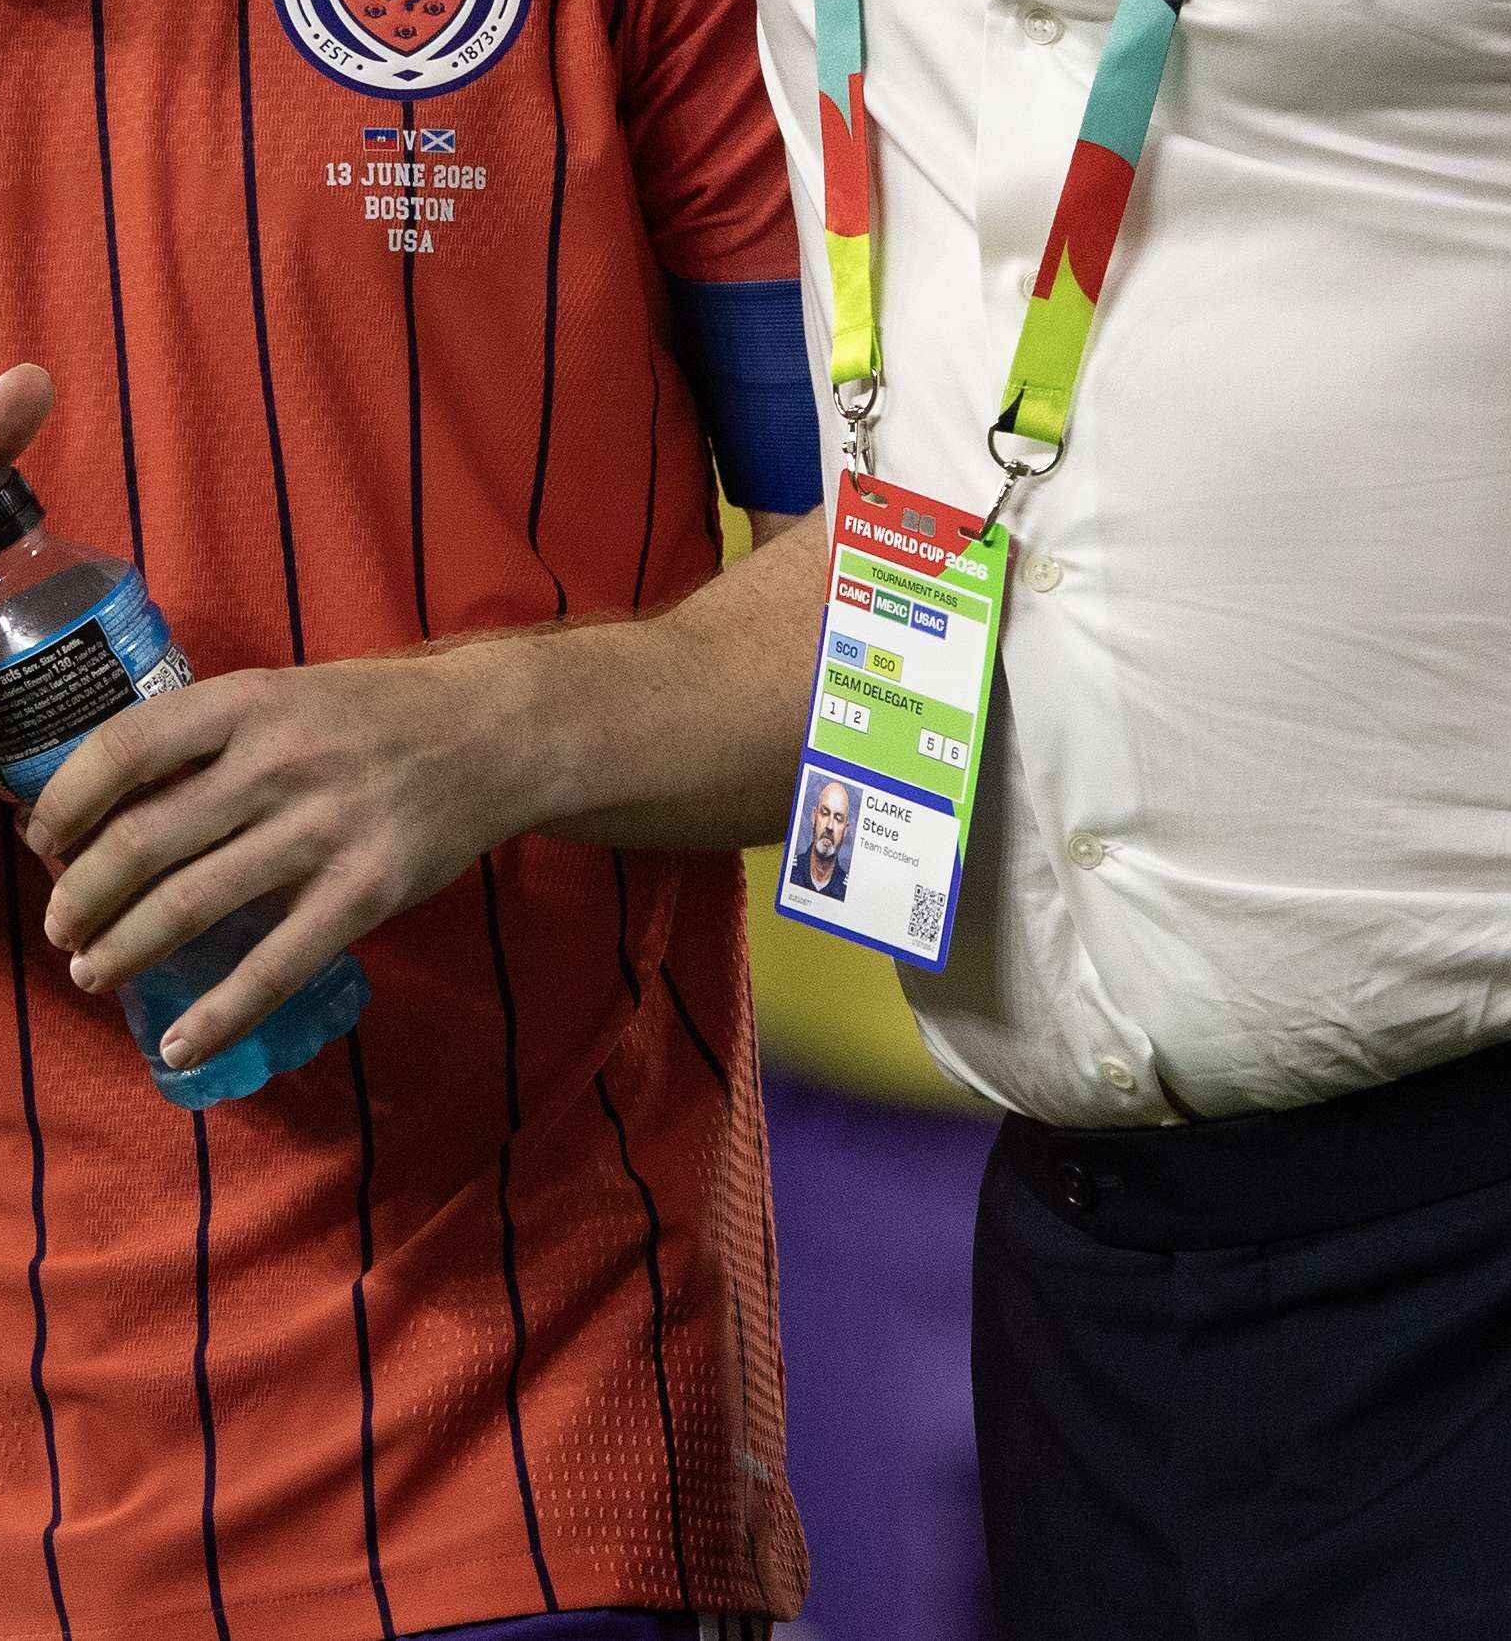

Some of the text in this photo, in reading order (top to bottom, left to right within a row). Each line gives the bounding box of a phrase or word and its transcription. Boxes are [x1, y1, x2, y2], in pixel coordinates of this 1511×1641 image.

[318, 30, 496, 68] EST 1873
[402, 130, 417, 153] V
[325, 162, 487, 190] 13 JUNE 2026
[364, 196, 455, 222] BOSTON
[388, 229, 434, 254] USA
[844, 515, 872, 539] FIFA
[873, 524, 918, 555] WORLD
[918, 542, 945, 563] CUP
[945, 551, 988, 580] 2026
[871, 567, 959, 608] TOURNAMENT PASS
[839, 583, 945, 632] CANC MEXC USAC
[835, 640, 895, 672] SCO SCO
[828, 669, 925, 716] TEAM DELEGATE
[829, 701, 960, 760] 1 2 5 6
[866, 795, 912, 824] CLARKE
[862, 817, 899, 842] Steve
[859, 837, 920, 868] Team Scotland
